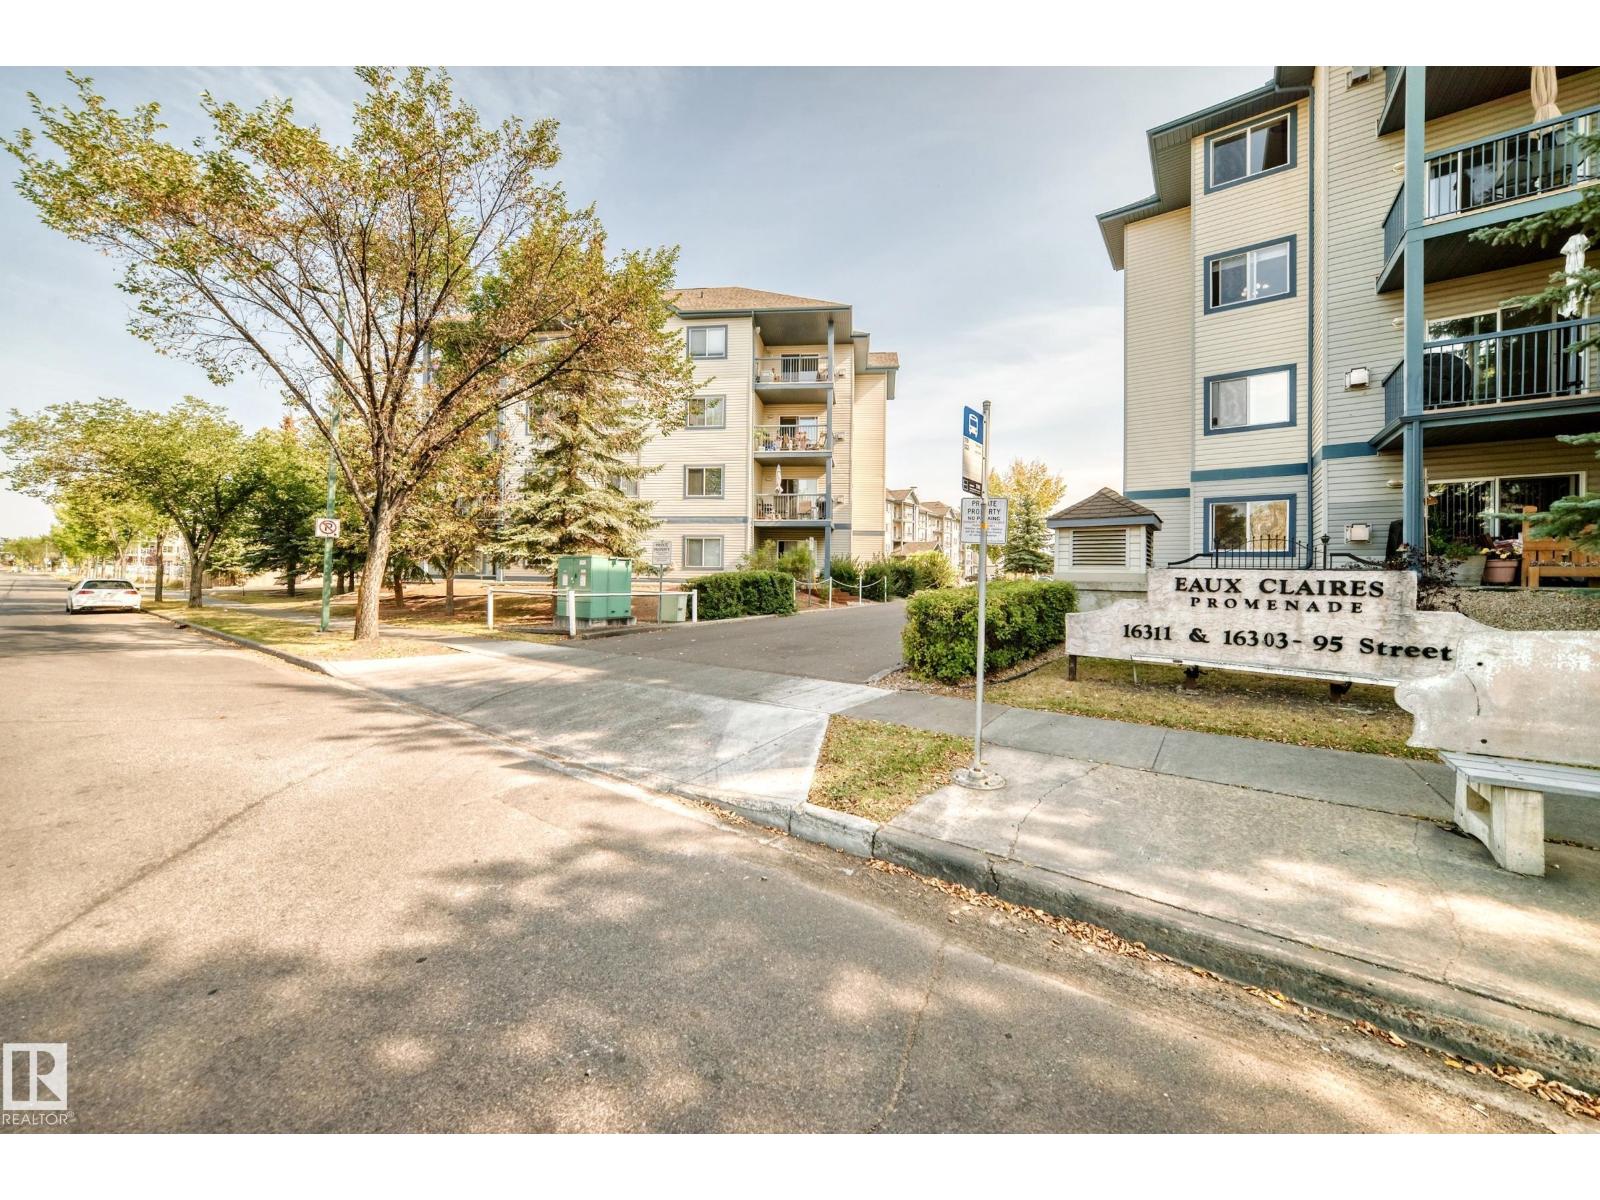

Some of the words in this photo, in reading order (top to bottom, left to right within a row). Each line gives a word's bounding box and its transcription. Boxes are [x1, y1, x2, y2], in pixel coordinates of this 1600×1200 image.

[1174, 576, 1242, 594] EAUX
[1258, 578, 1384, 598] CLAIRES
[1190, 596, 1363, 614] PROMENADE
[1123, 623, 1172, 641] 16311
[1188, 627, 1210, 644] &
[1313, 635, 1344, 653] 95
[1359, 637, 1453, 662] Street
